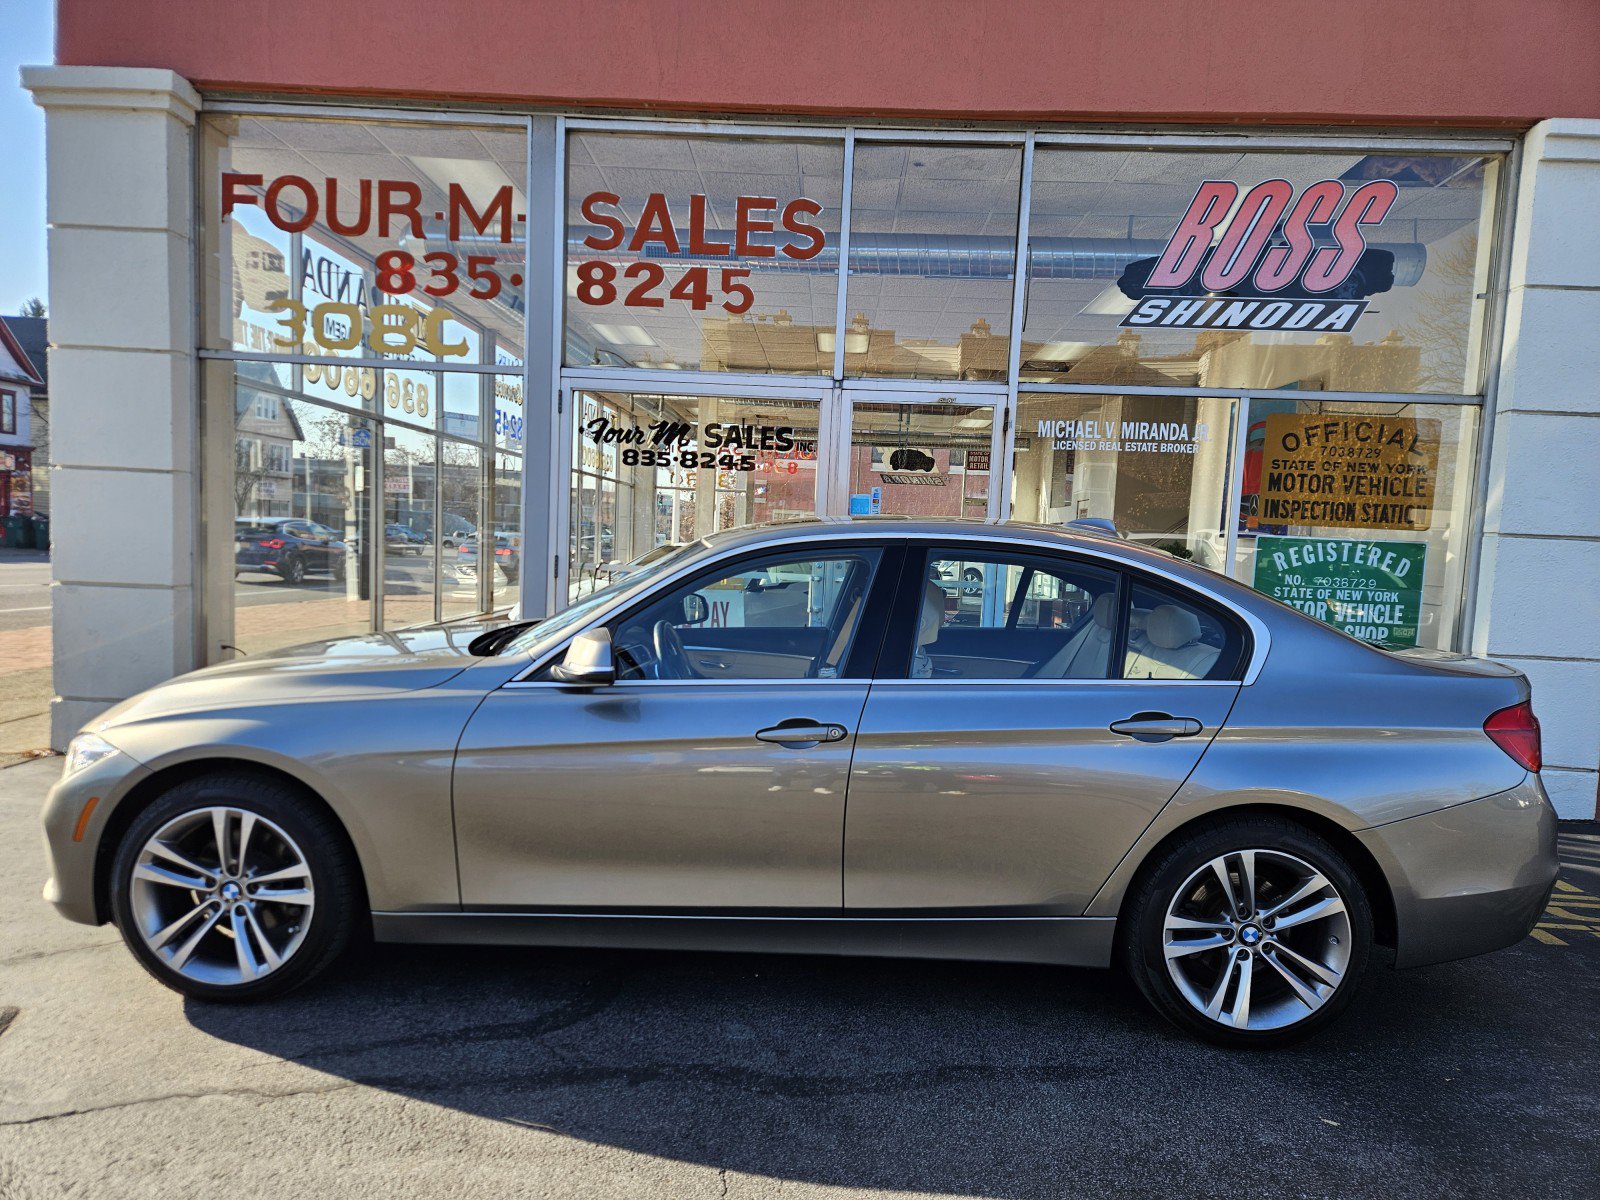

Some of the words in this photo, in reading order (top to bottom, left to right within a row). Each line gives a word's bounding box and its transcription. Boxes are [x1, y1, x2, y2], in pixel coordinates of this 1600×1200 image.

[580, 191, 826, 260] SALES
[1143, 178, 1399, 293] BOSS
[576, 260, 755, 314] 8245
[1129, 299, 1359, 331] SHINODA
[704, 422, 794, 452] SALES
[1038, 420, 1101, 438] MICHAEL
[1121, 421, 1189, 441] MIRANDA
[1282, 421, 1426, 456] OFFICIAL
[1052, 440, 1097, 451] LICENSED
[1099, 441, 1123, 452] REAL
[1125, 441, 1158, 453] ESTATE
[1160, 443, 1200, 454] BROKER
[1271, 459, 1317, 472] STATE
[1321, 461, 1342, 472] OF
[1346, 462, 1379, 474] NEW
[1385, 463, 1428, 476] YORK
[1267, 473, 1336, 494] MOTOR
[1342, 475, 1428, 498] VEHICLE
[1263, 499, 1357, 522] INSPECTION
[1272, 542, 1411, 578] REGISTERED
[1314, 576, 1377, 588] 7038729
[1274, 587, 1314, 599] STATE
[1316, 589, 1332, 600] OF
[1336, 590, 1363, 601] NEW
[1367, 591, 1399, 603] YORK
[1336, 602, 1405, 625] VEHICLE
[1344, 625, 1389, 641] SHOP
